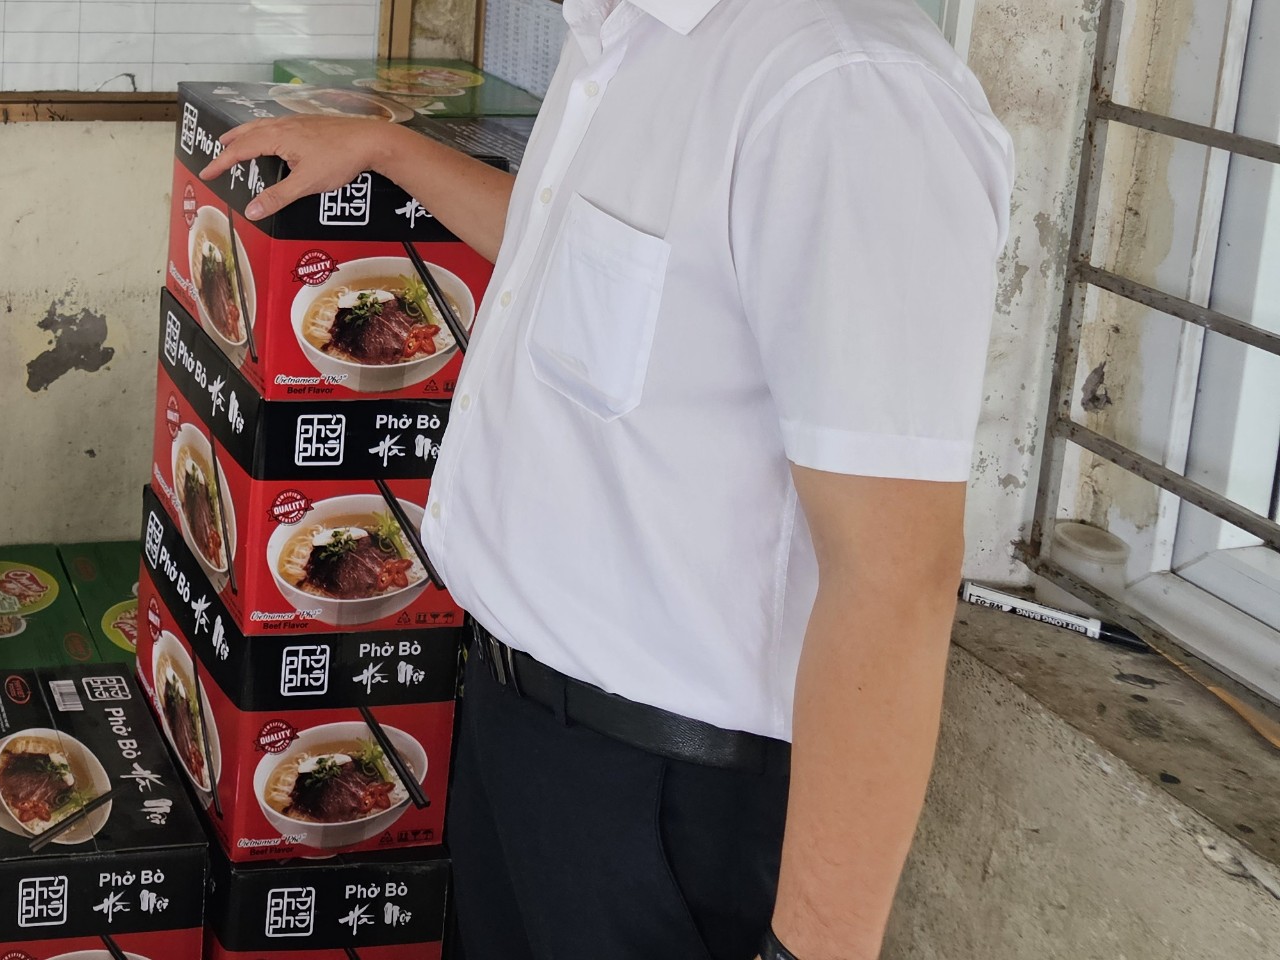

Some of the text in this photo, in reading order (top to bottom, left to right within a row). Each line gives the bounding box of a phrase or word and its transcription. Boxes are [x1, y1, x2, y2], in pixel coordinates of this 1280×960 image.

[298, 261, 331, 275] QUALITY
[376, 414, 440, 430] Phở Bò
[273, 499, 306, 516] QUALITY
[360, 641, 421, 657] Phở Bò
[260, 731, 291, 745] QUALITY
[99, 869, 165, 887] Phở Bò
[345, 882, 408, 899] Phở Bò
